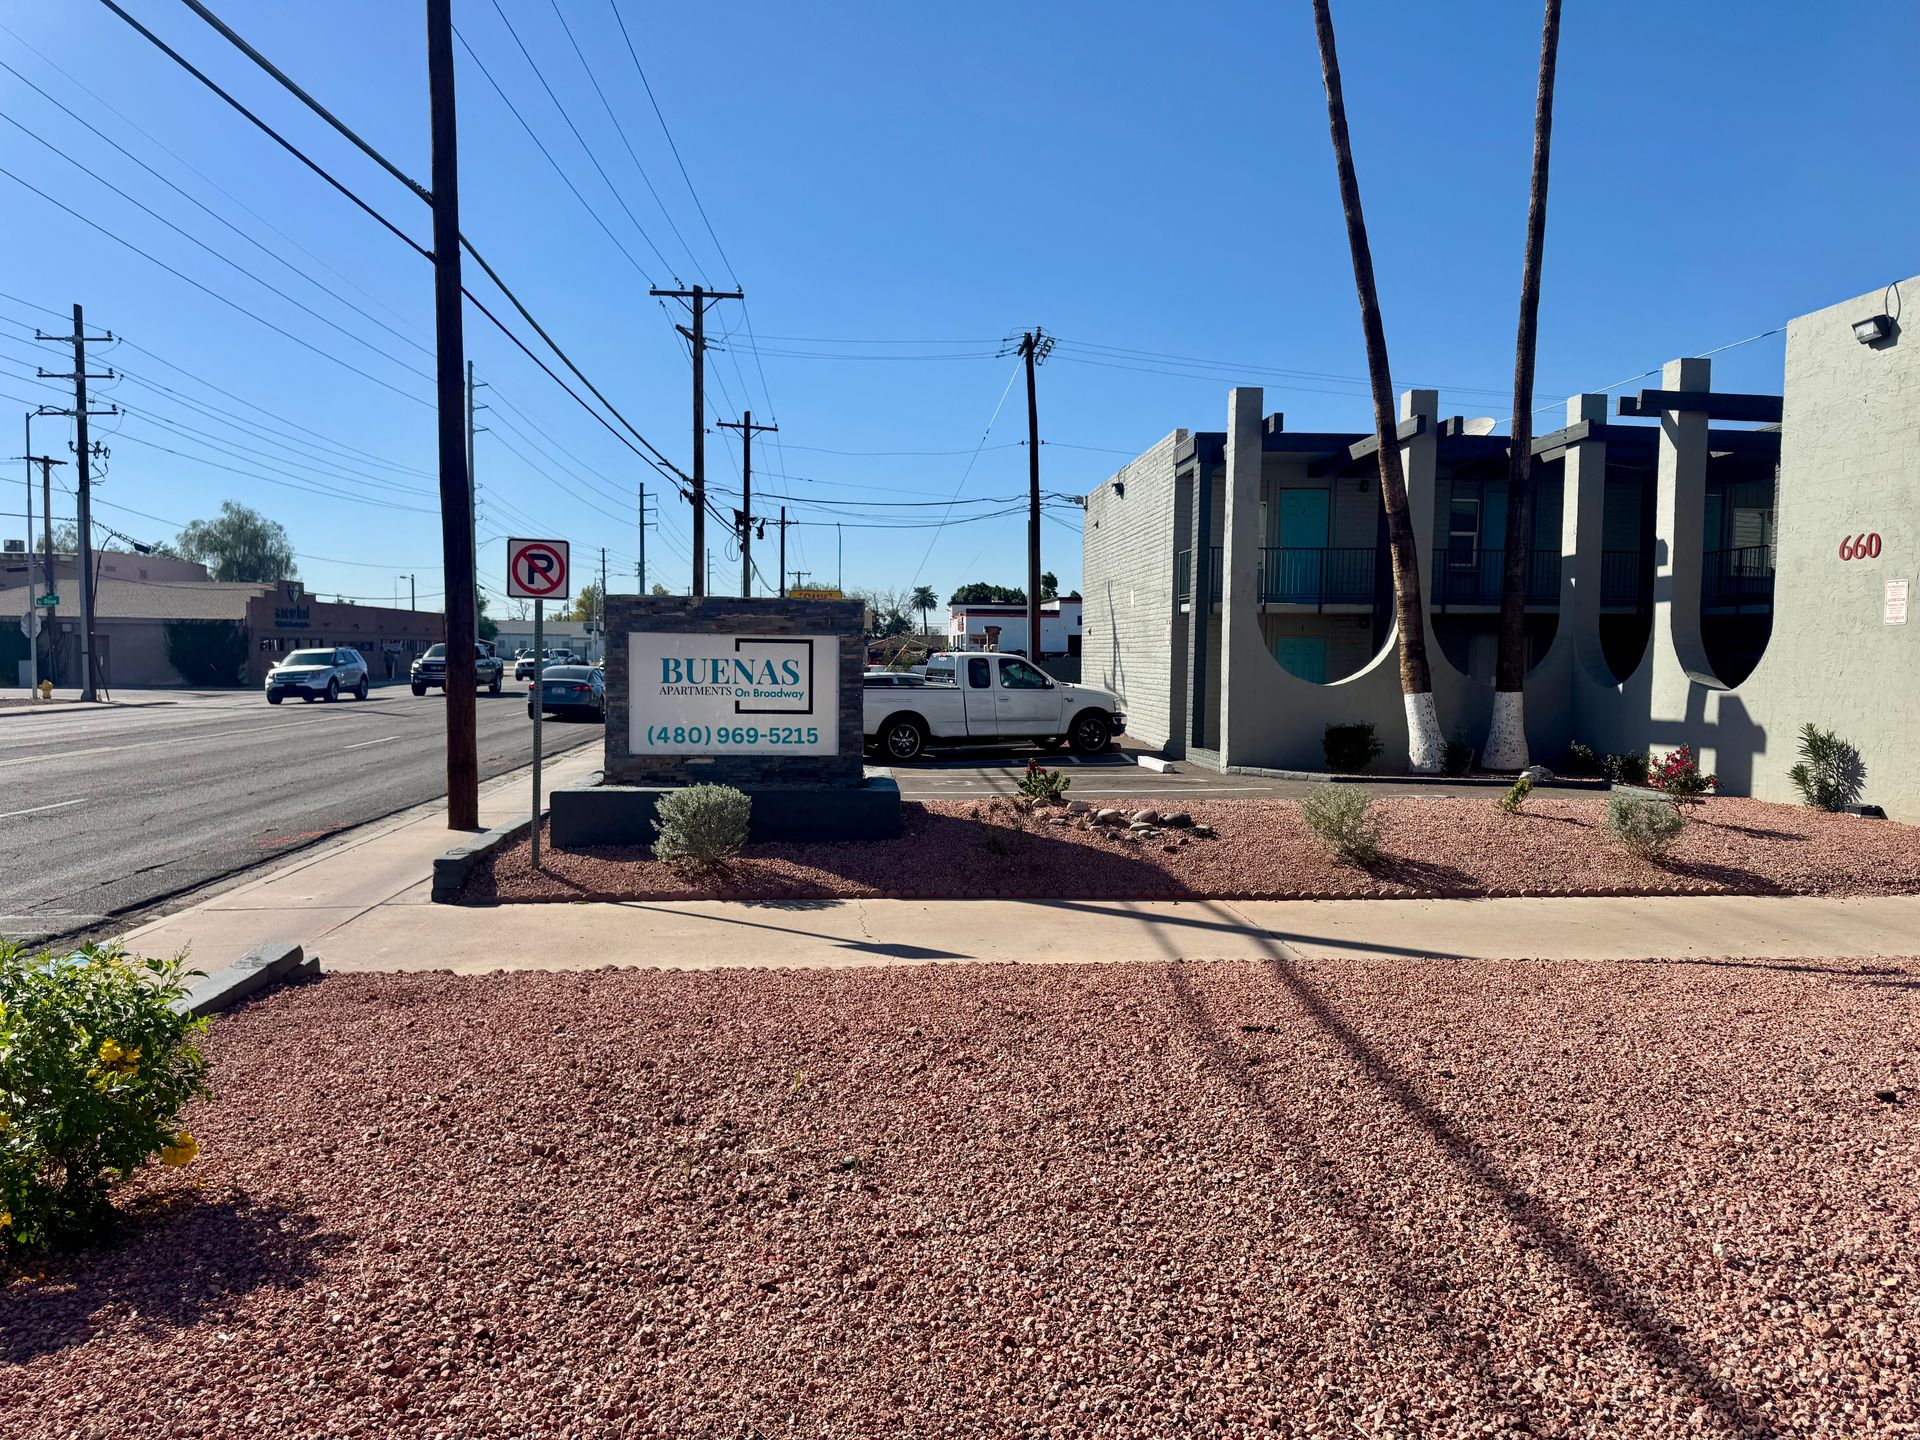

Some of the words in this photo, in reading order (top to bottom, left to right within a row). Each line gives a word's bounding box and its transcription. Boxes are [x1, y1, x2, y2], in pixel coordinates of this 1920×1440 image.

[1839, 532, 1882, 561] 660
[660, 657, 800, 686] BUENAS
[659, 686, 732, 696] APARTMENTS
[735, 688, 750, 698] On
[753, 688, 804, 701] Broadway
[647, 725, 711, 746] (480)
[717, 727, 819, 745] 969-5215
